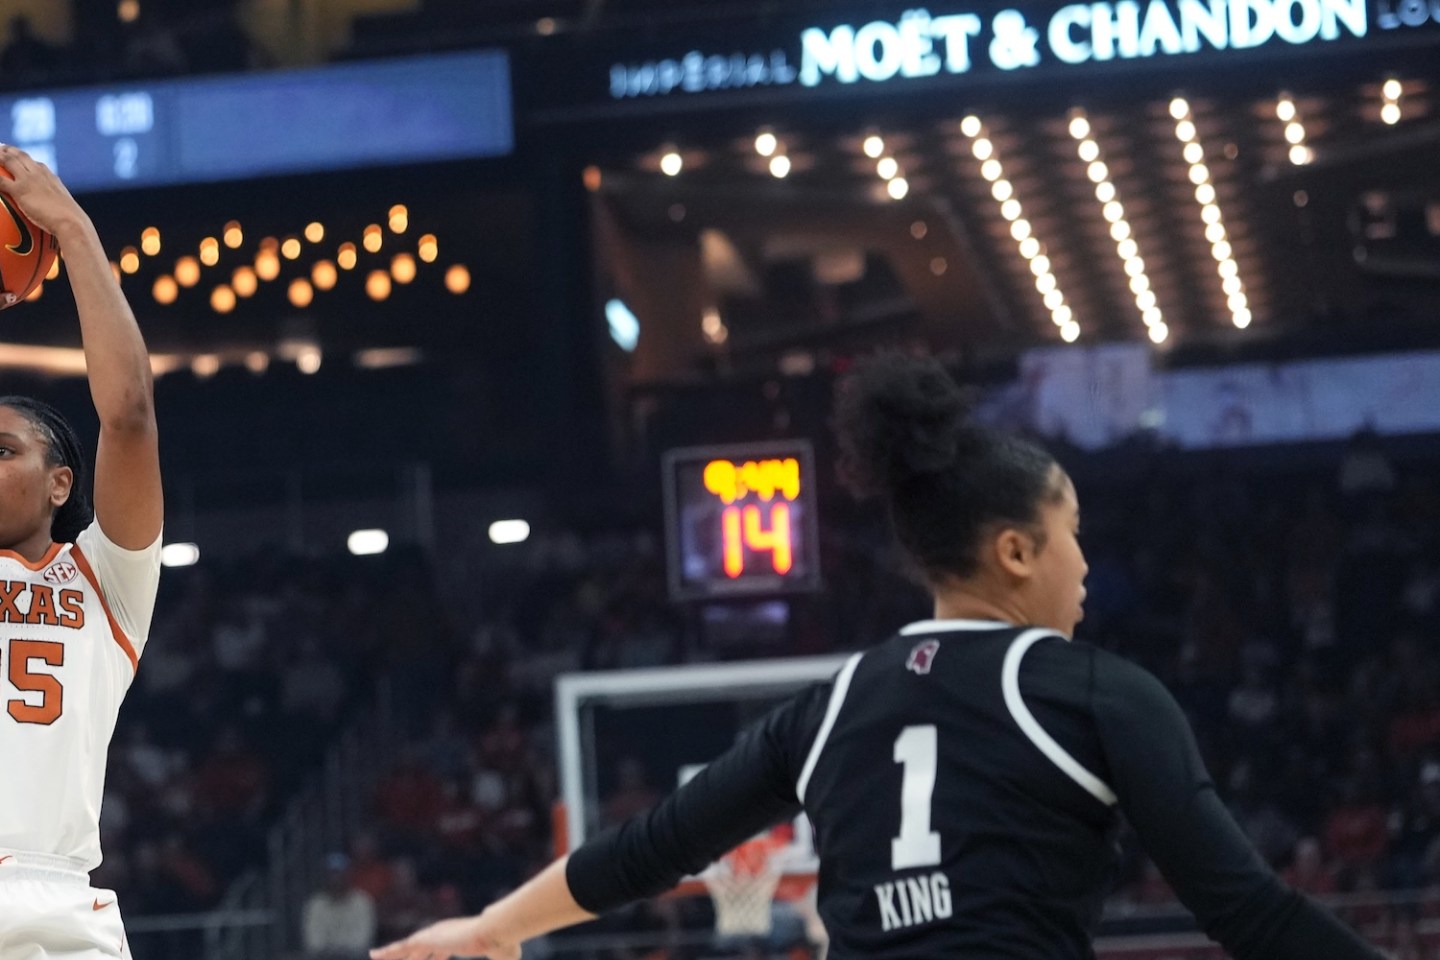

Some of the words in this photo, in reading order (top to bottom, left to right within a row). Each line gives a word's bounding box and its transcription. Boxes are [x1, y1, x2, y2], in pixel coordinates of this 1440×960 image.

[799, 9, 981, 87] MOËT
[989, 9, 1039, 70] &
[1048, 0, 1367, 64] CHANDON
[44, 563, 76, 584] SEC
[722, 502, 792, 578] 14
[891, 724, 942, 871] 1
[874, 872, 953, 932] KING
